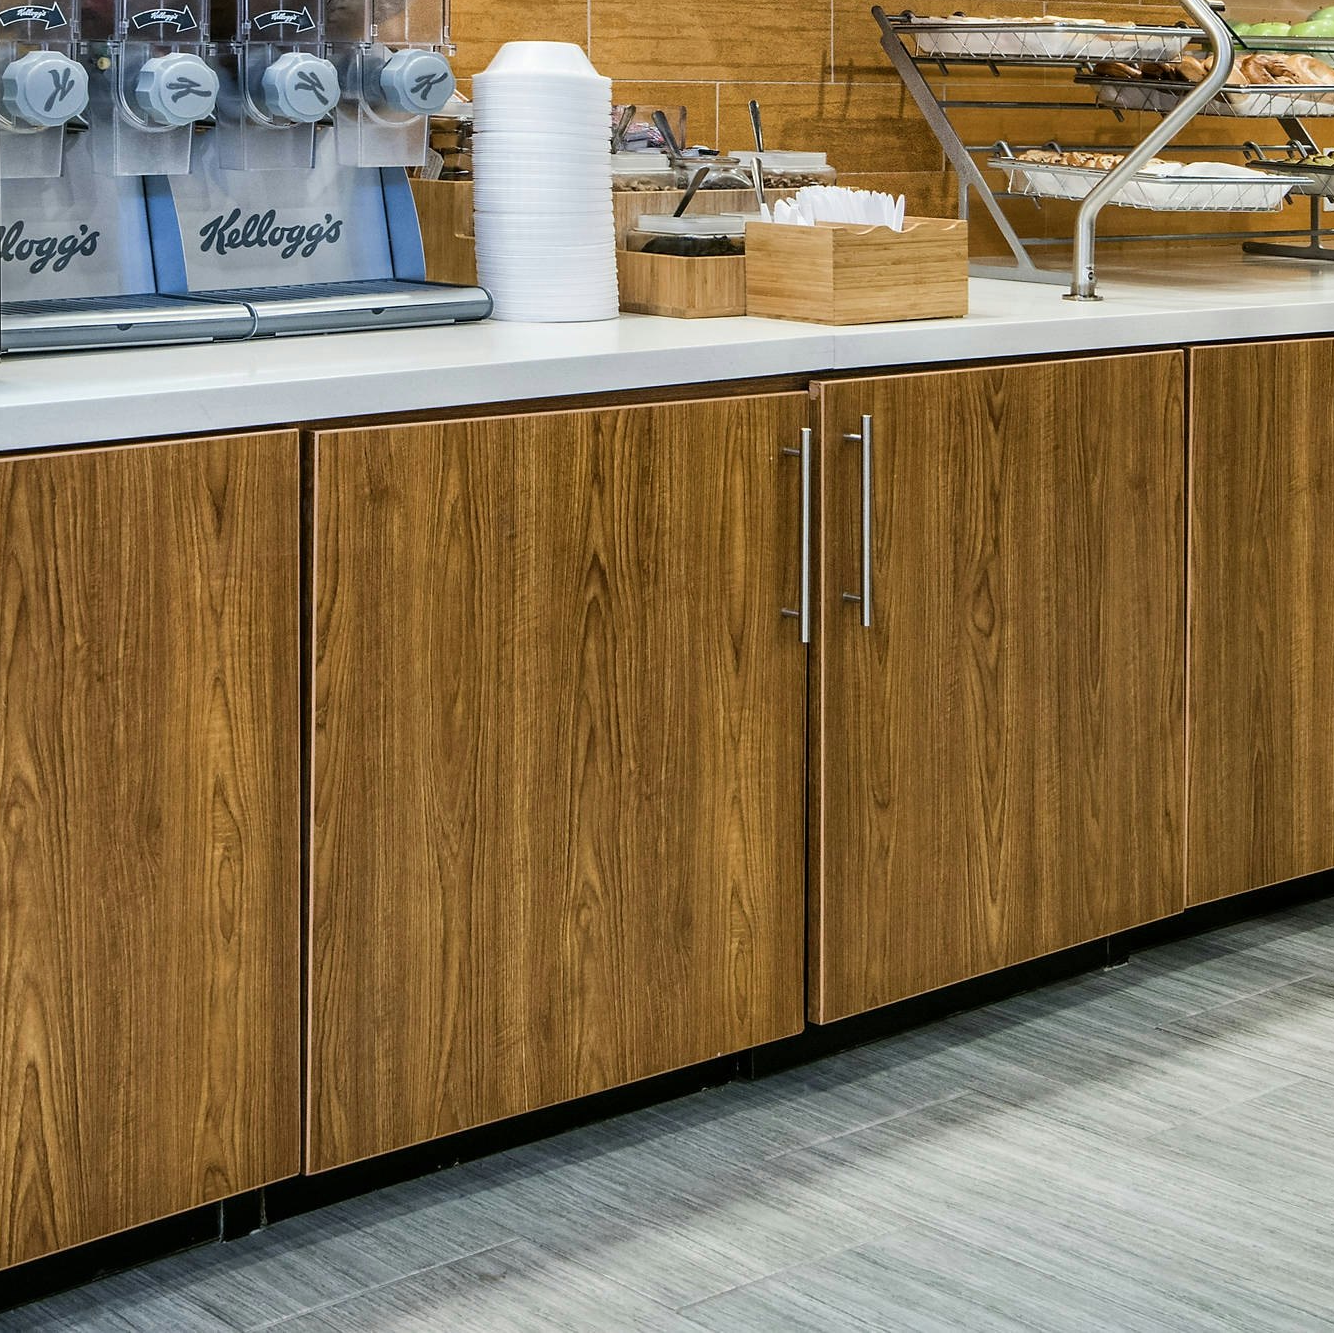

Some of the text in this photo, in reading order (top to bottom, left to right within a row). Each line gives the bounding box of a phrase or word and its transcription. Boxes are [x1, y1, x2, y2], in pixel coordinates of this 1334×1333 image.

[16, 8, 47, 19] Kellogg's
[150, 10, 178, 21] Kellogg's
[271, 11, 298, 22] Kellogg's
[200, 208, 343, 259] Kellogg's
[0, 219, 100, 275] logg's
